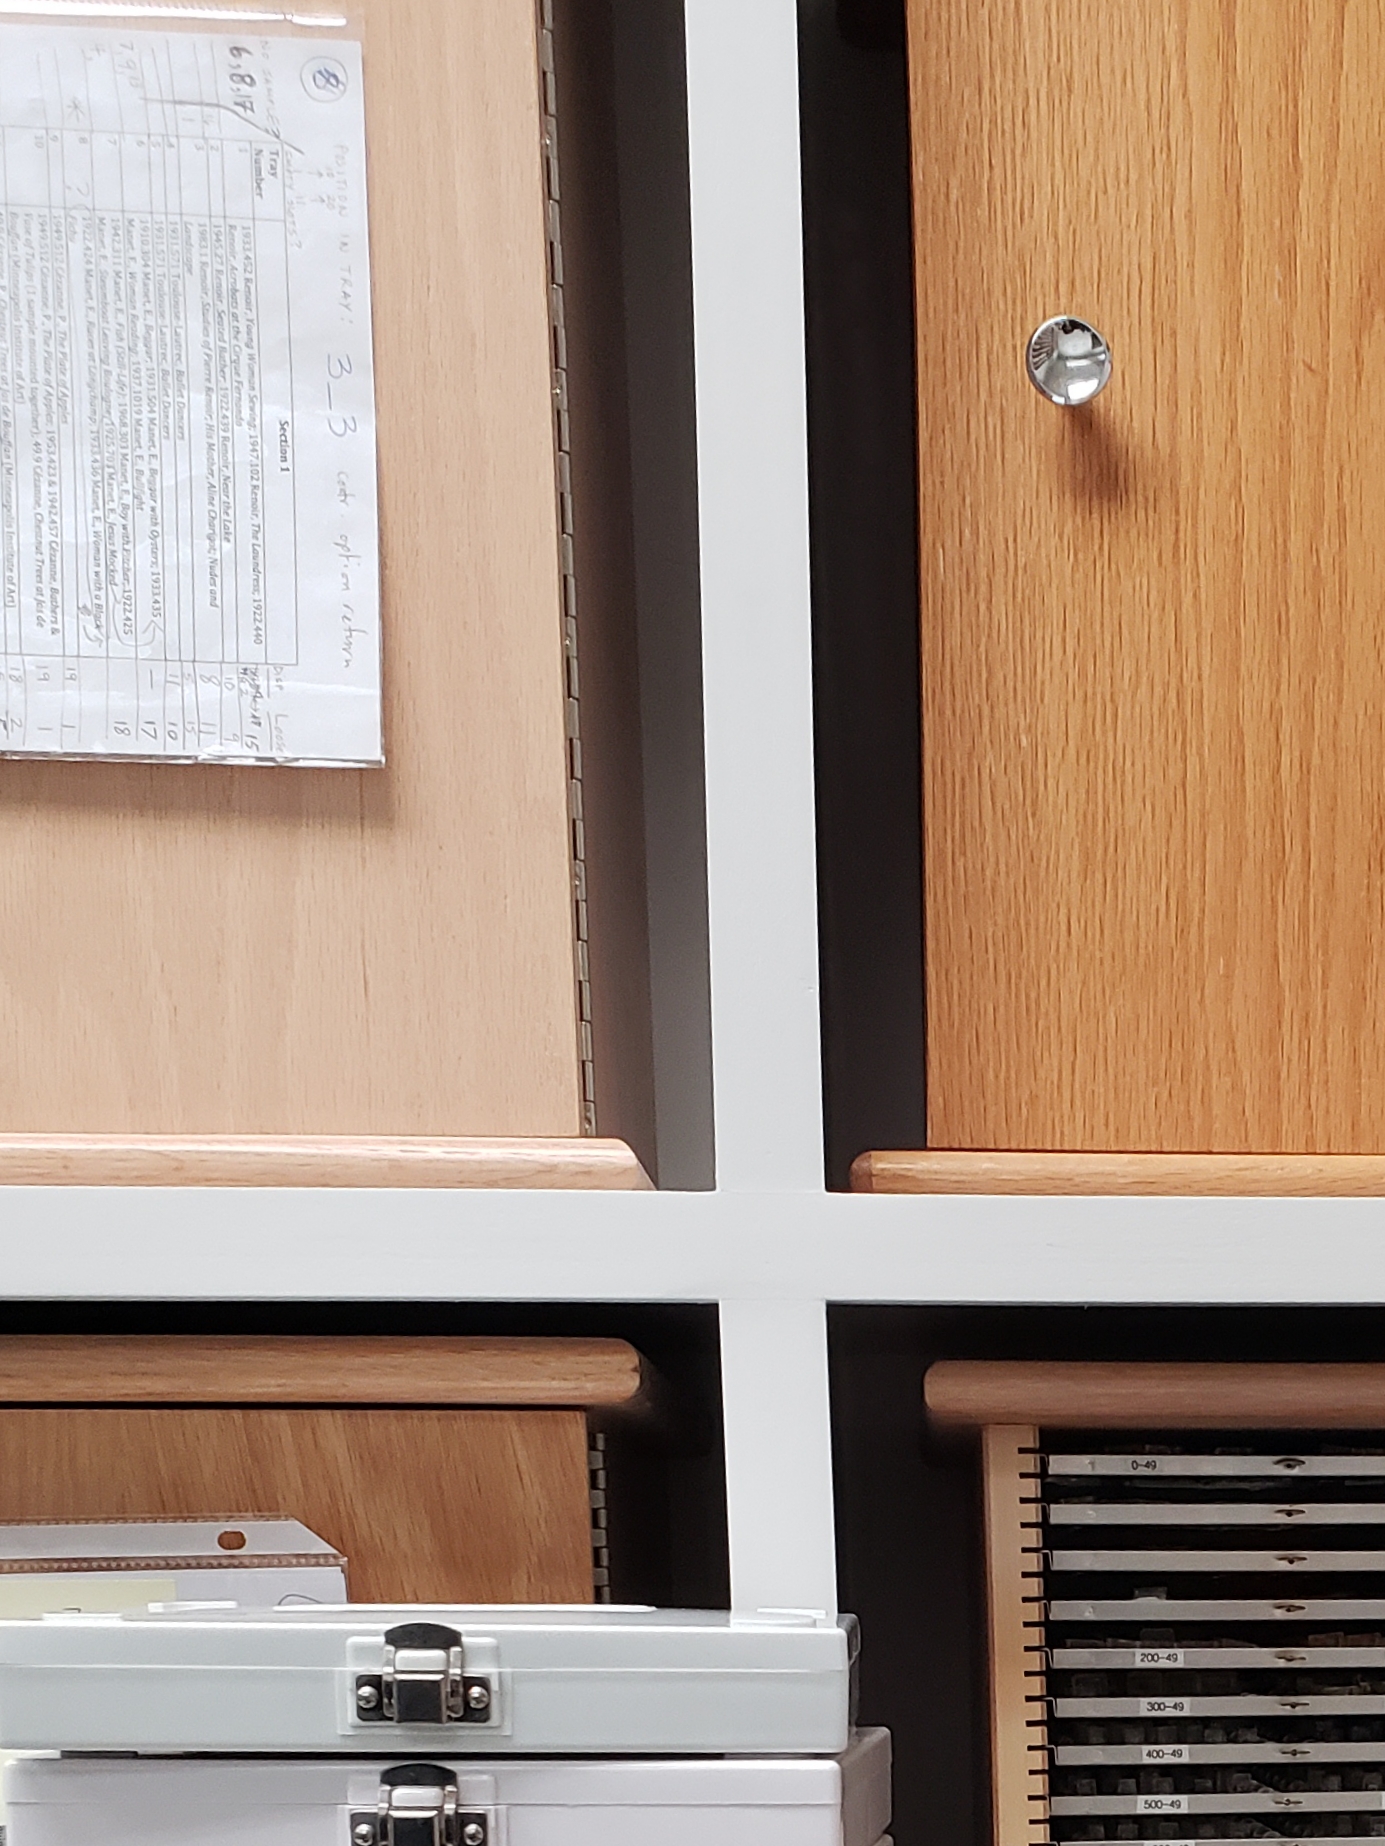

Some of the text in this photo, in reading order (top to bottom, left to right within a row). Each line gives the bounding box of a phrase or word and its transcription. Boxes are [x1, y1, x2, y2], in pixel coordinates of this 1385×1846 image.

[254, 149, 264, 200] Number
[268, 150, 280, 179] Tray
[280, 420, 290, 464] Section
[250, 434, 260, 482] 1947.102
[222, 475, 232, 499] Near
[223, 501, 232, 516] the
[250, 485, 261, 521] Renoir,
[223, 518, 233, 543] Lake
[252, 524, 261, 541] The
[92, 530, 103, 567] Woman
[93, 571, 103, 592] with
[209, 557, 219, 588] Nudes
[210, 589, 220, 608] and
[1131, 1461, 1157, 1470] 0-49
[1140, 1652, 1178, 1663] 200-49
[1147, 1701, 1184, 1712] 300-49
[1146, 1748, 1183, 1759] 400-49
[1144, 1799, 1181, 1810] 500-49
